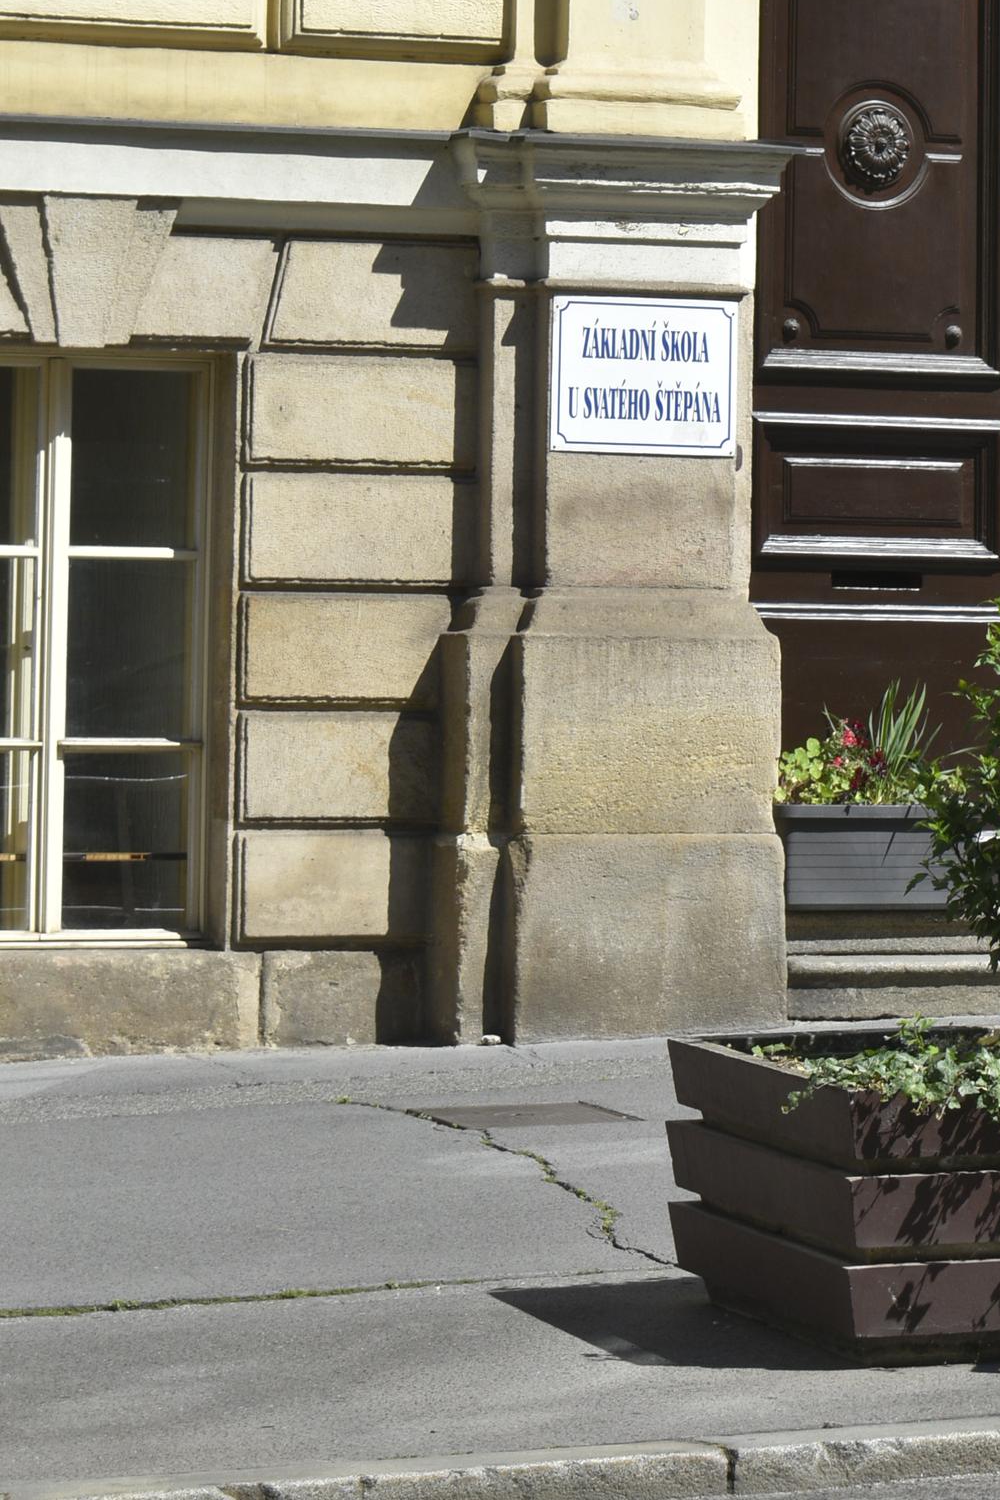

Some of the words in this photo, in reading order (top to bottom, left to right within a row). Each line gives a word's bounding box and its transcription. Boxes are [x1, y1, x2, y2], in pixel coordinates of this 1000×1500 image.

[582, 318, 657, 361] ZÁKLADNÍ
[661, 321, 709, 363] ŠKOLA
[568, 386, 579, 418] U
[583, 379, 650, 420] SVATÉHO
[655, 380, 721, 423] ŠTĚPÁNA
